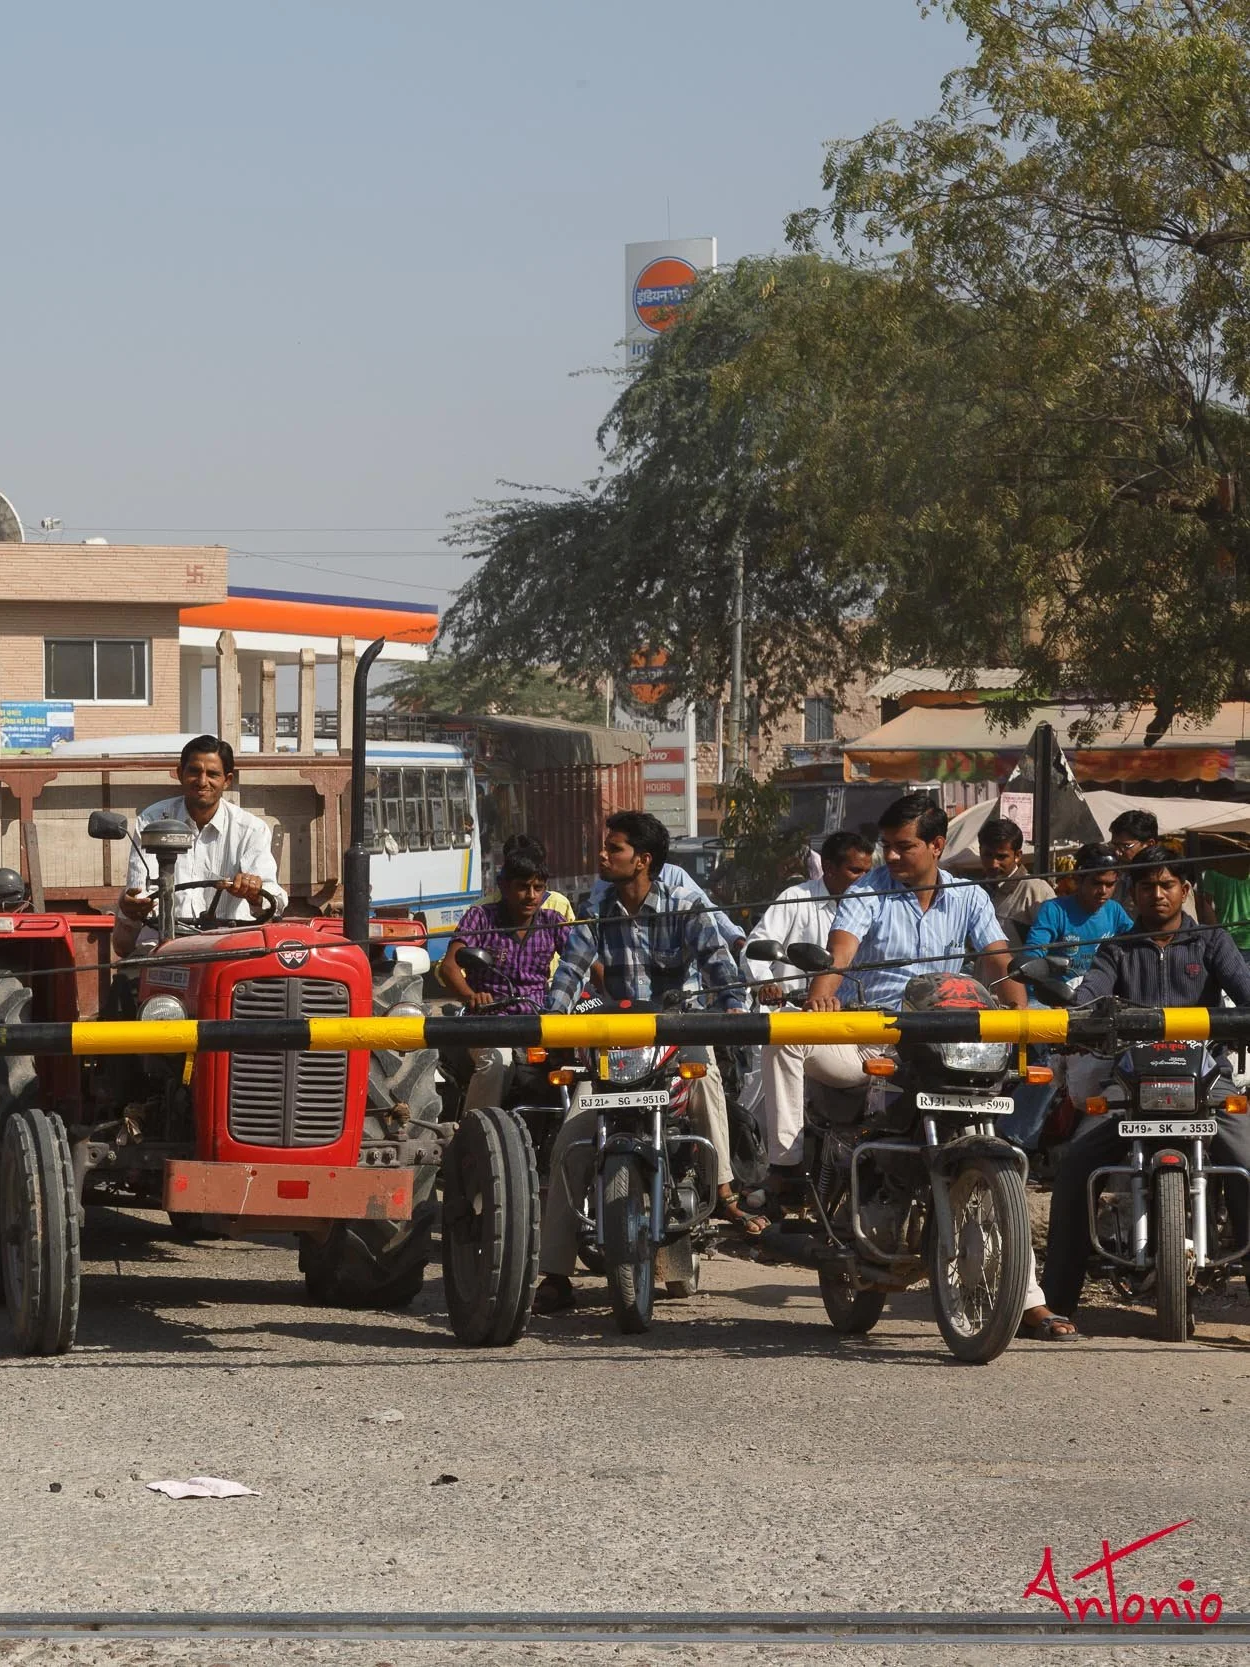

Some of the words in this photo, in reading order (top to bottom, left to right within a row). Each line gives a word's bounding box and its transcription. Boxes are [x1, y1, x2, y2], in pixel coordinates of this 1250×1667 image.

[645, 782, 671, 792] HOURS
[618, 1096, 631, 1106] SG
[642, 1094, 666, 1104] 9516
[958, 1098, 973, 1109] SA
[986, 1099, 1011, 1111] 5999
[1158, 1123, 1173, 1134] SK
[1189, 1123, 1214, 1133] 3533
